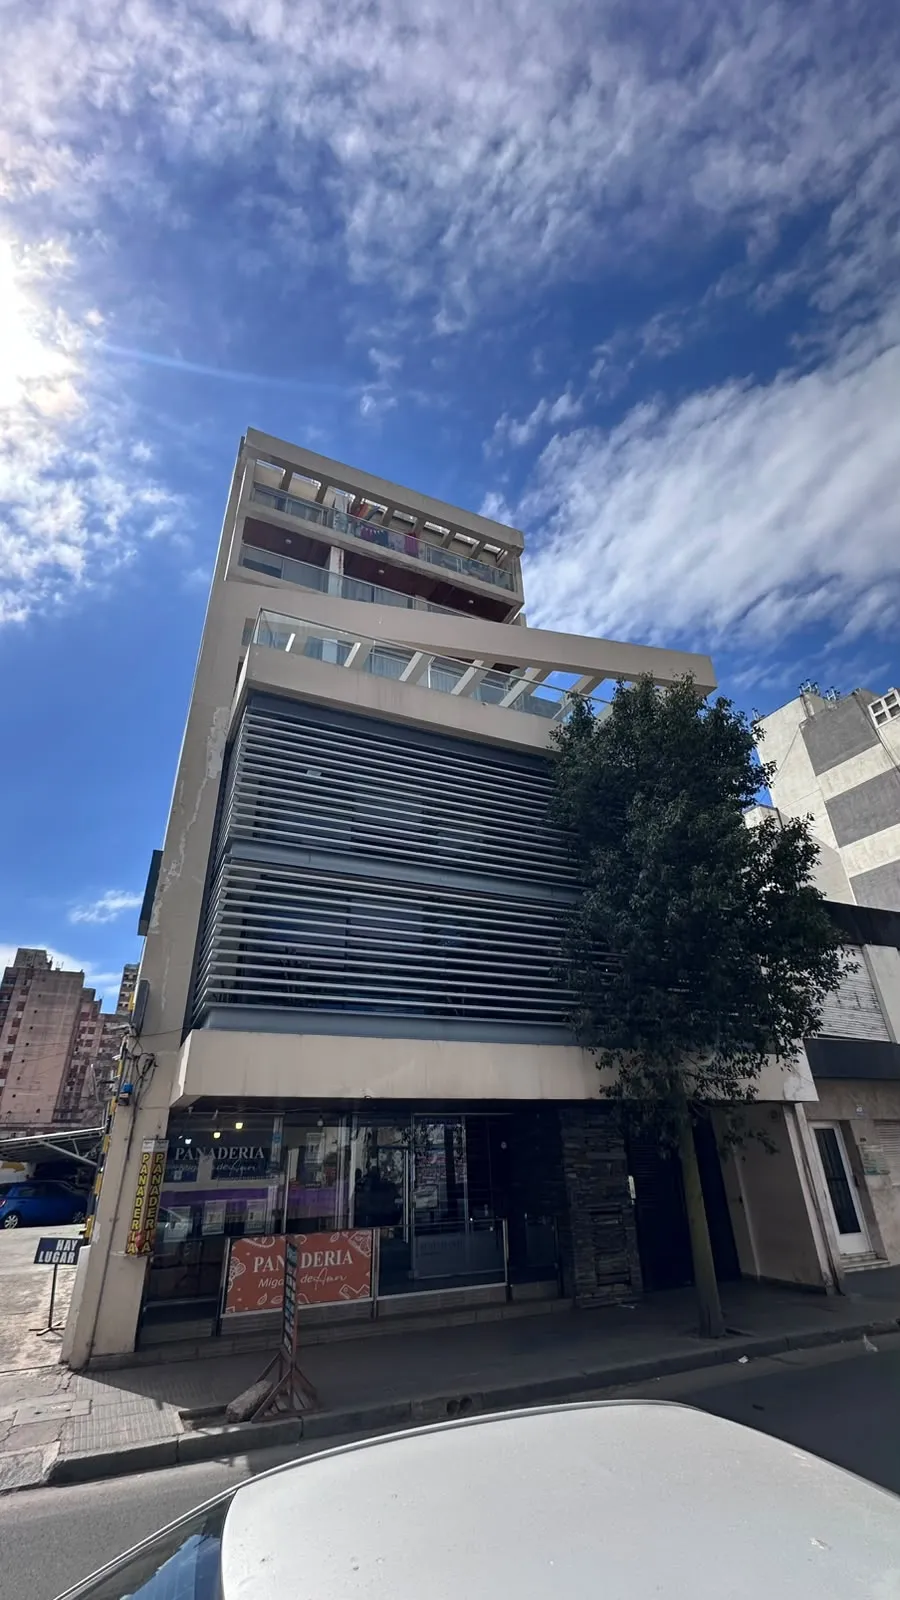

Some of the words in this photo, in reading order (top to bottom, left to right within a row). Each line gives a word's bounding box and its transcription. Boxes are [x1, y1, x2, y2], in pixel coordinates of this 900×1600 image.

[175, 1146, 265, 1160] PANADERIA
[127, 1153, 151, 1255] PANADERIA
[141, 1153, 164, 1253] PANADERIA
[56, 1239, 78, 1251] HAY
[38, 1250, 76, 1264] LUGAR
[253, 1249, 353, 1273] PANDERIA
